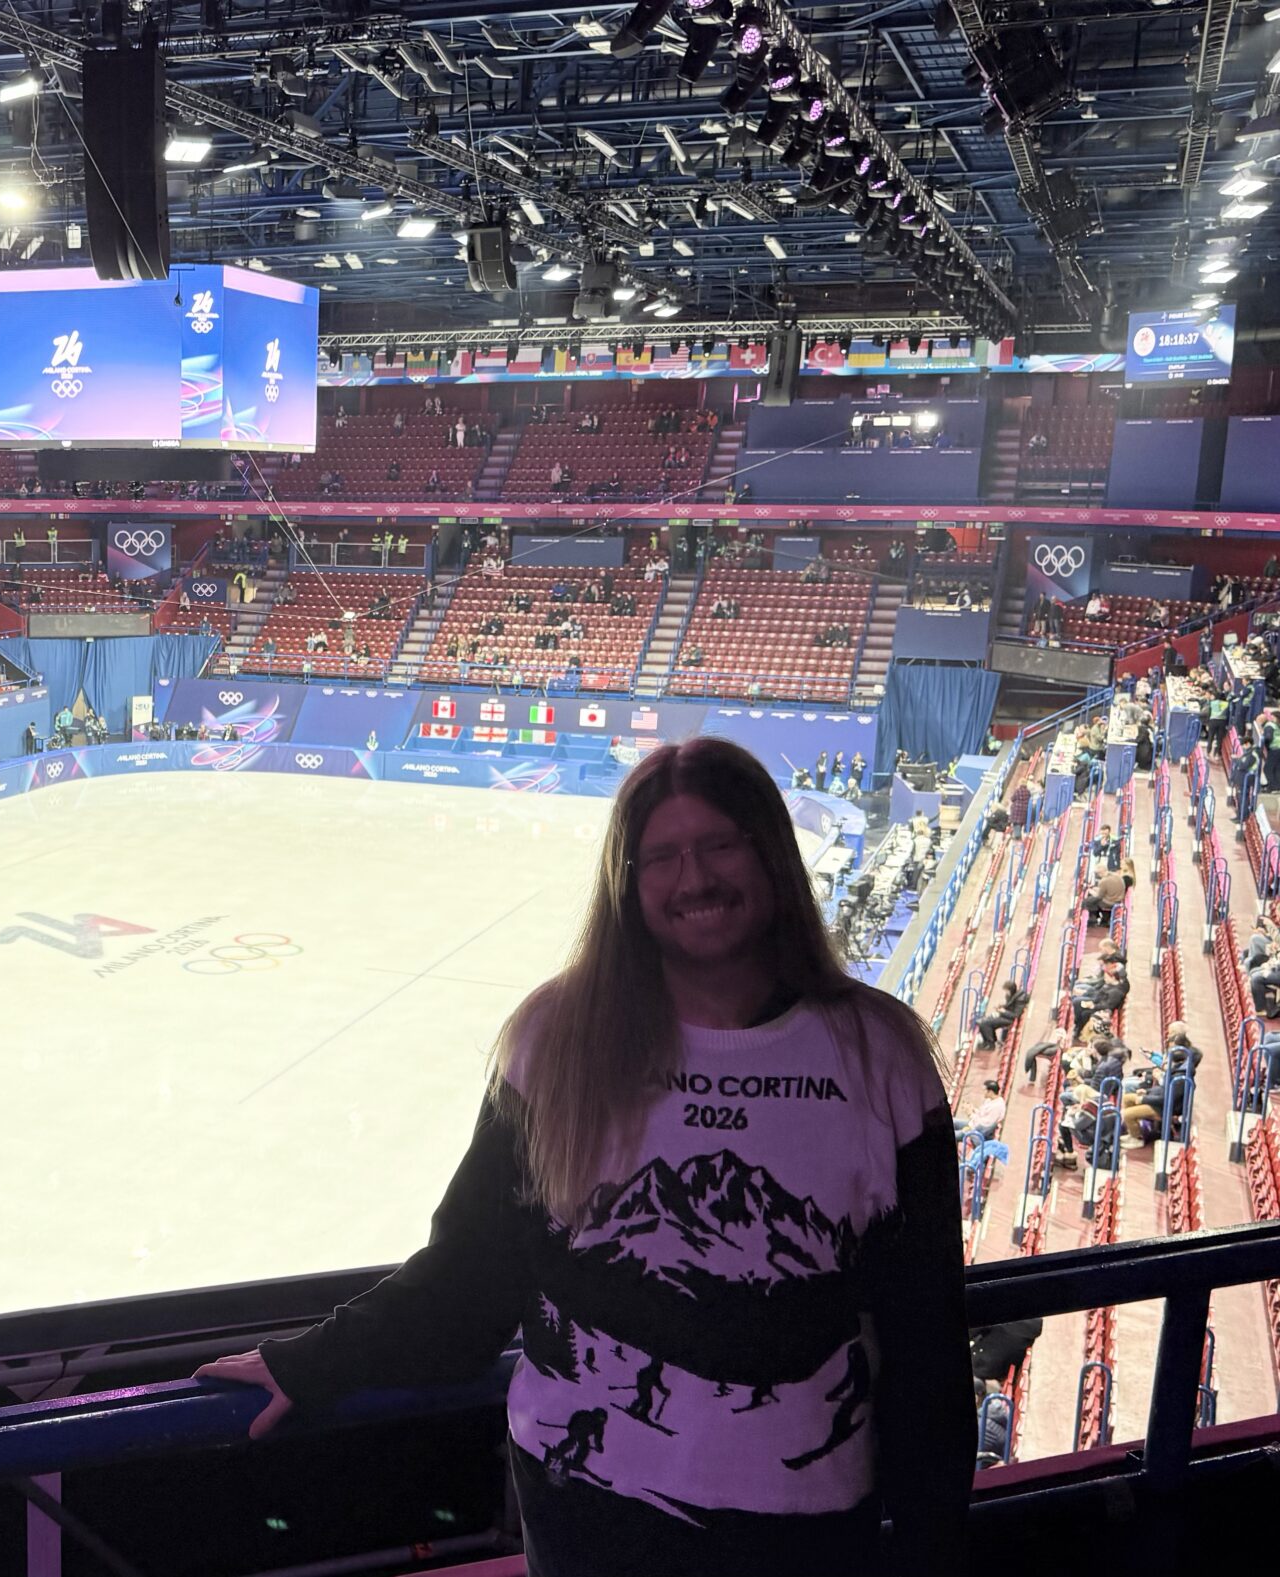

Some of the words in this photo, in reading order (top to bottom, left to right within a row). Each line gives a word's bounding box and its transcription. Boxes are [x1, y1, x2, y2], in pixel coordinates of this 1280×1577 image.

[1158, 332, 1200, 347] 18:18:37
[92, 943, 165, 979] MILANO
[155, 914, 231, 944] CORTINA
[717, 1075, 849, 1103] CORTINA
[683, 1102, 749, 1131] 2026
